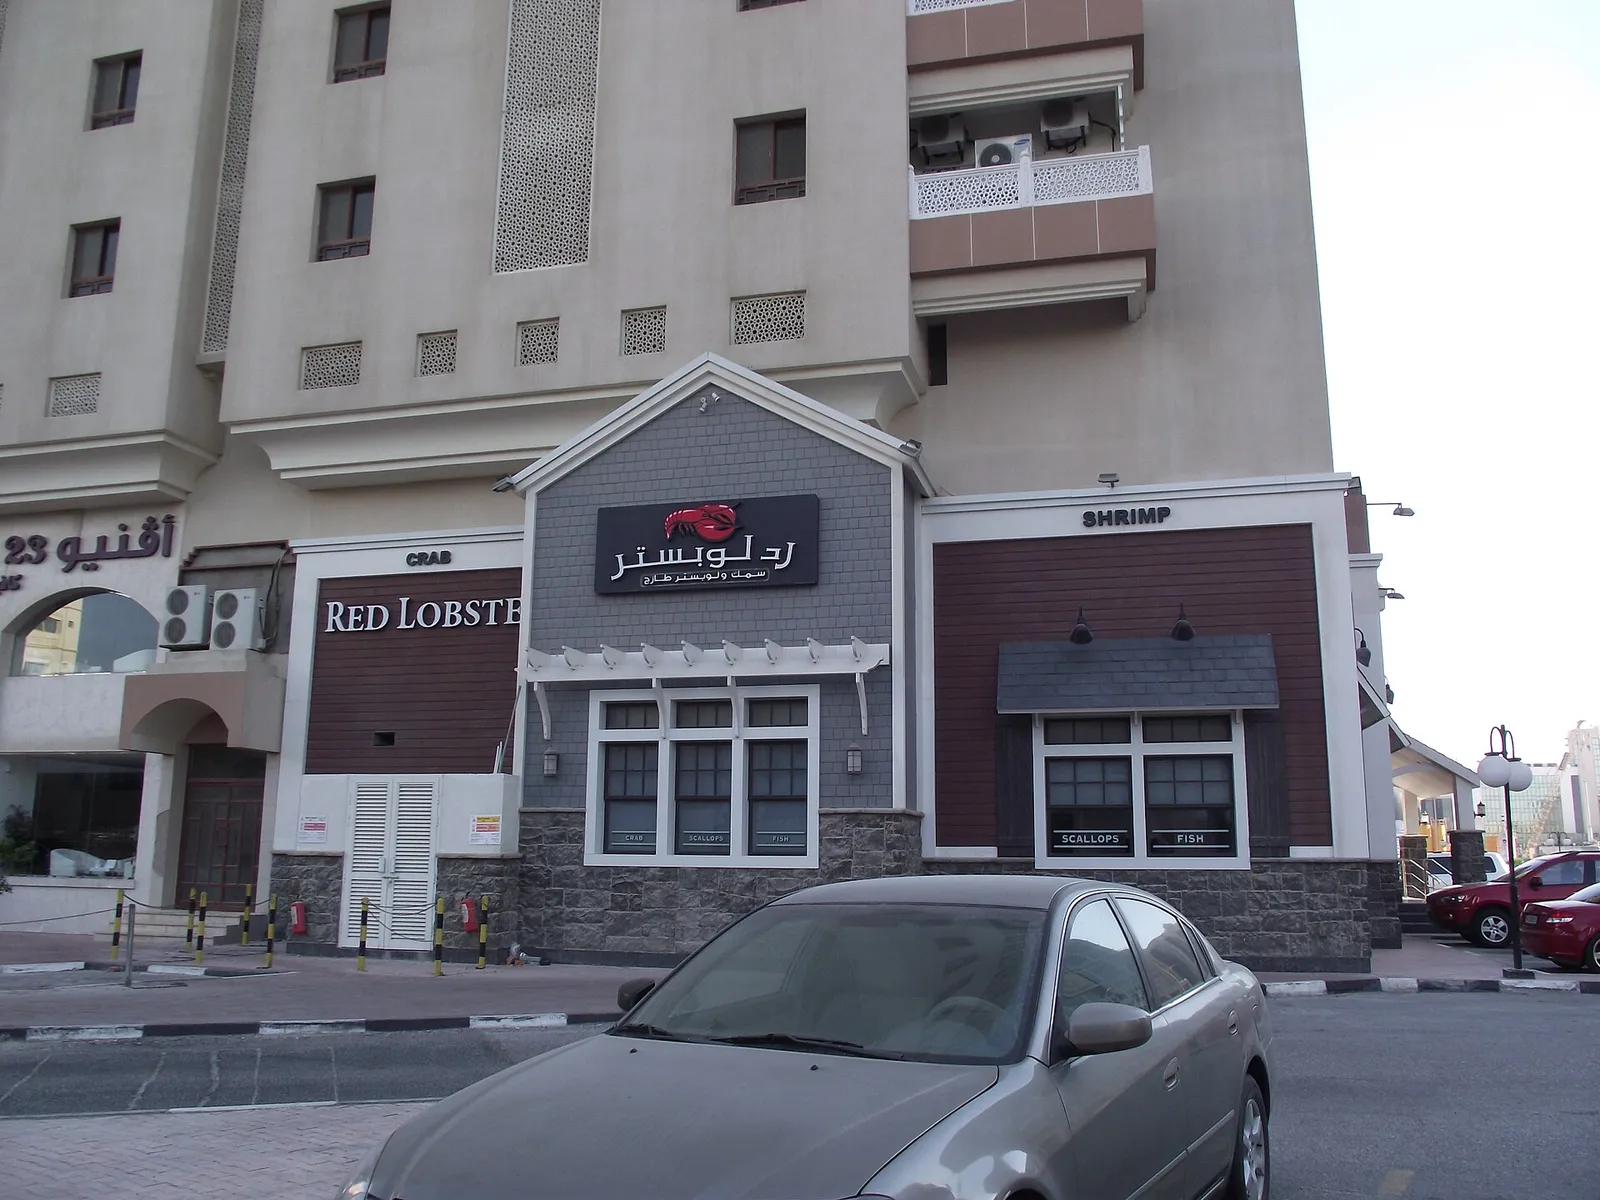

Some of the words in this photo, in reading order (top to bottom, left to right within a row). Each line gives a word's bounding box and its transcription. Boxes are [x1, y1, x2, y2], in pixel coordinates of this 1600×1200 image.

[1082, 506, 1171, 527] SHRIMP
[4, 535, 48, 565] 23
[406, 550, 452, 566] CRAB
[610, 534, 755, 581] لوبستر
[760, 541, 796, 570] رد
[731, 569, 766, 579] سمك
[324, 601, 390, 633] RED
[625, 834, 643, 842] CRAB
[689, 834, 724, 842] SCALLOPS
[1061, 834, 1120, 844] SCALLOPS
[1177, 834, 1204, 843] FISH
